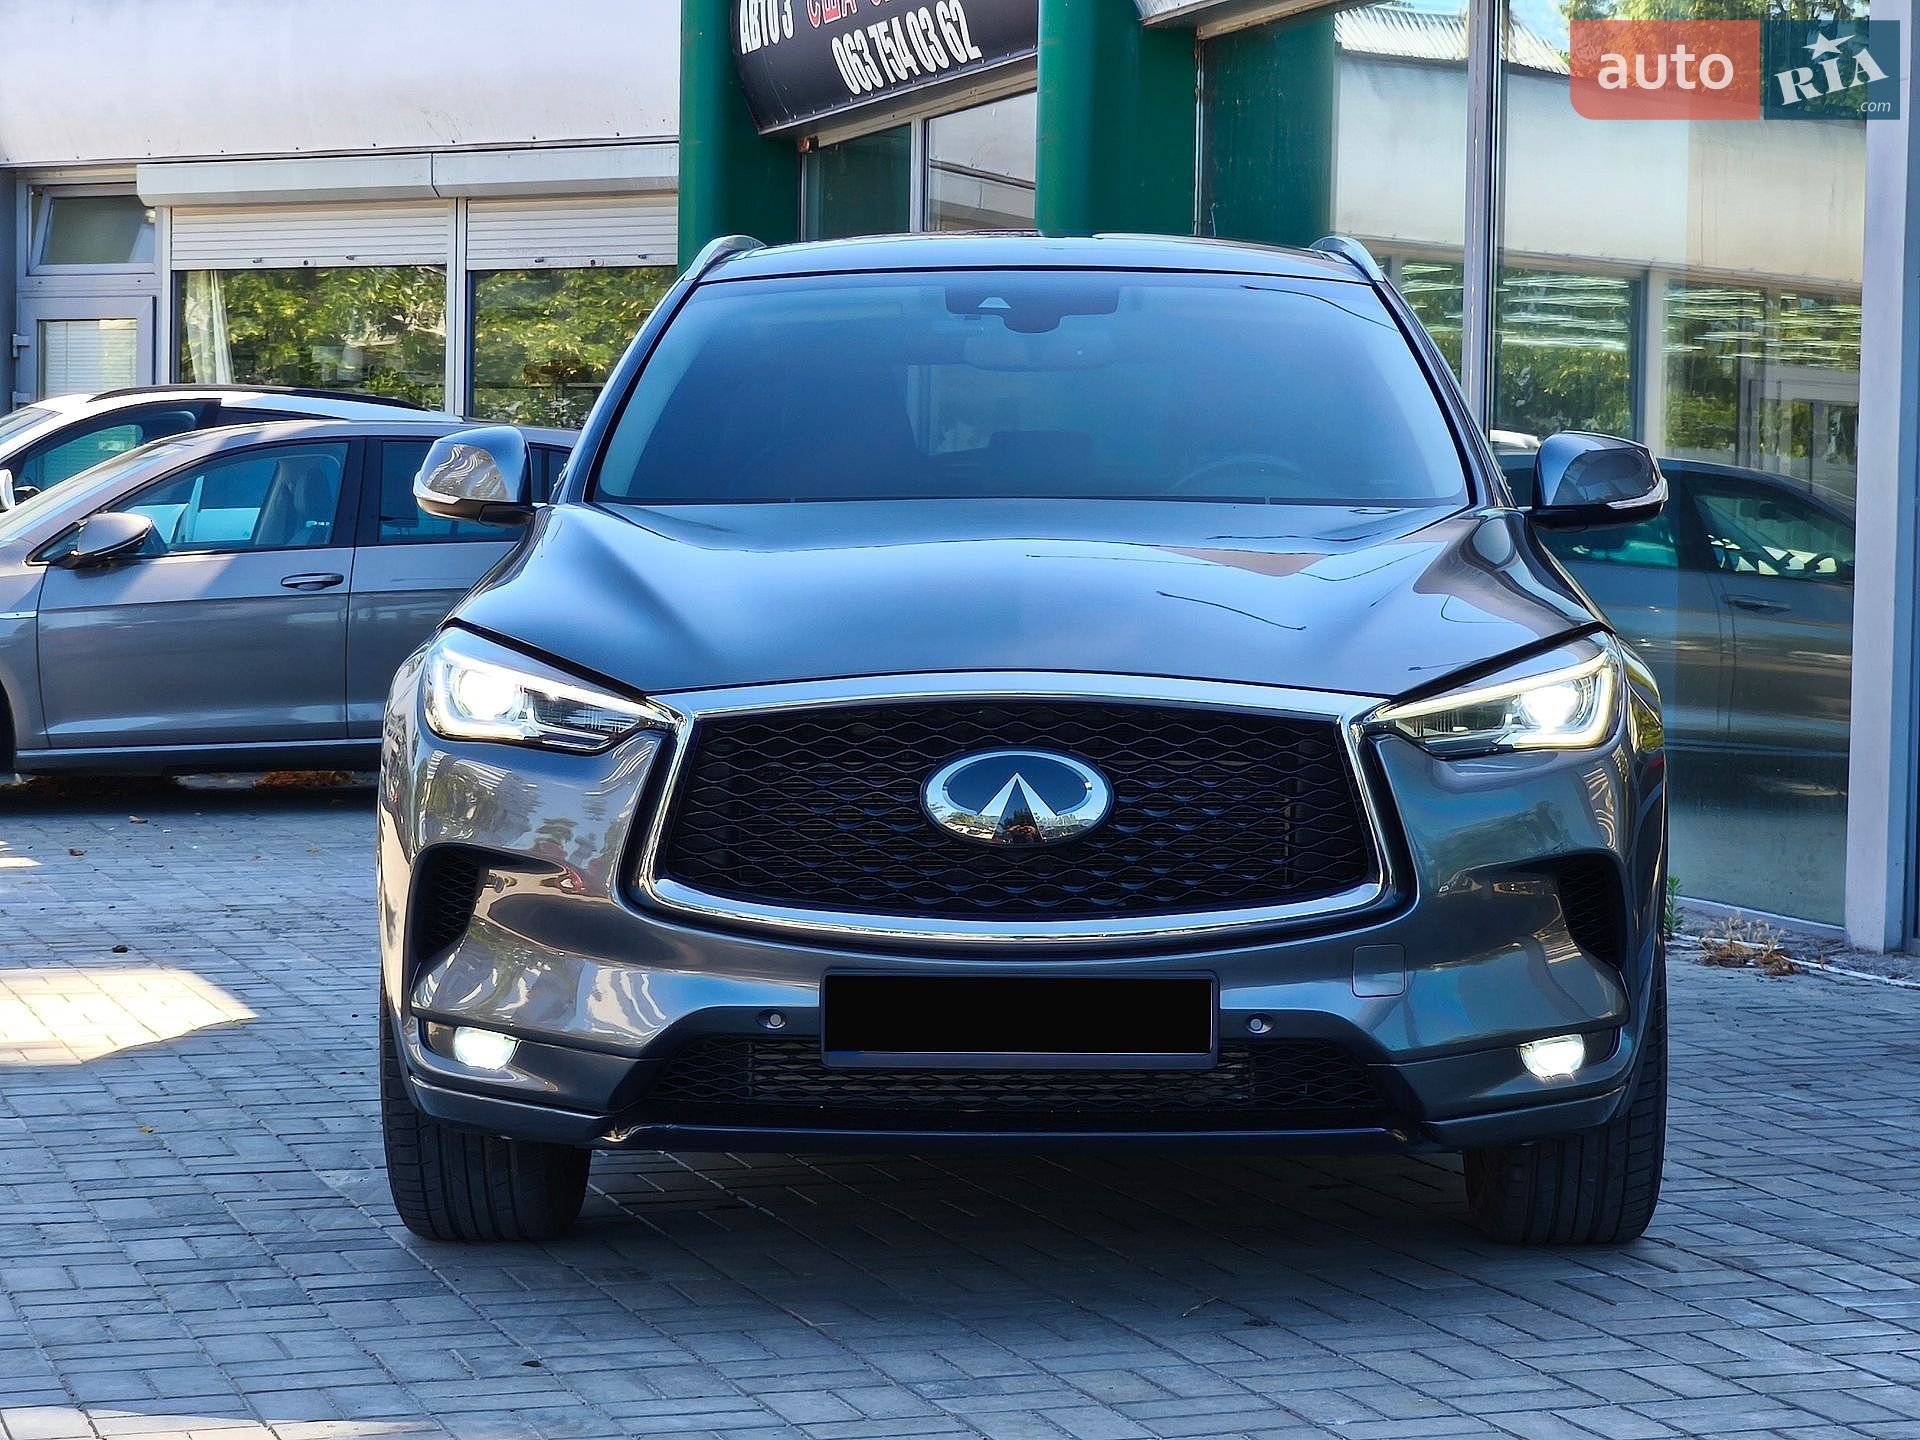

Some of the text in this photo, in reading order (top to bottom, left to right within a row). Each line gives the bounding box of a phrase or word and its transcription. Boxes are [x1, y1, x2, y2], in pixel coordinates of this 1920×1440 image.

[831, 0, 983, 95] 063 754 03 62
